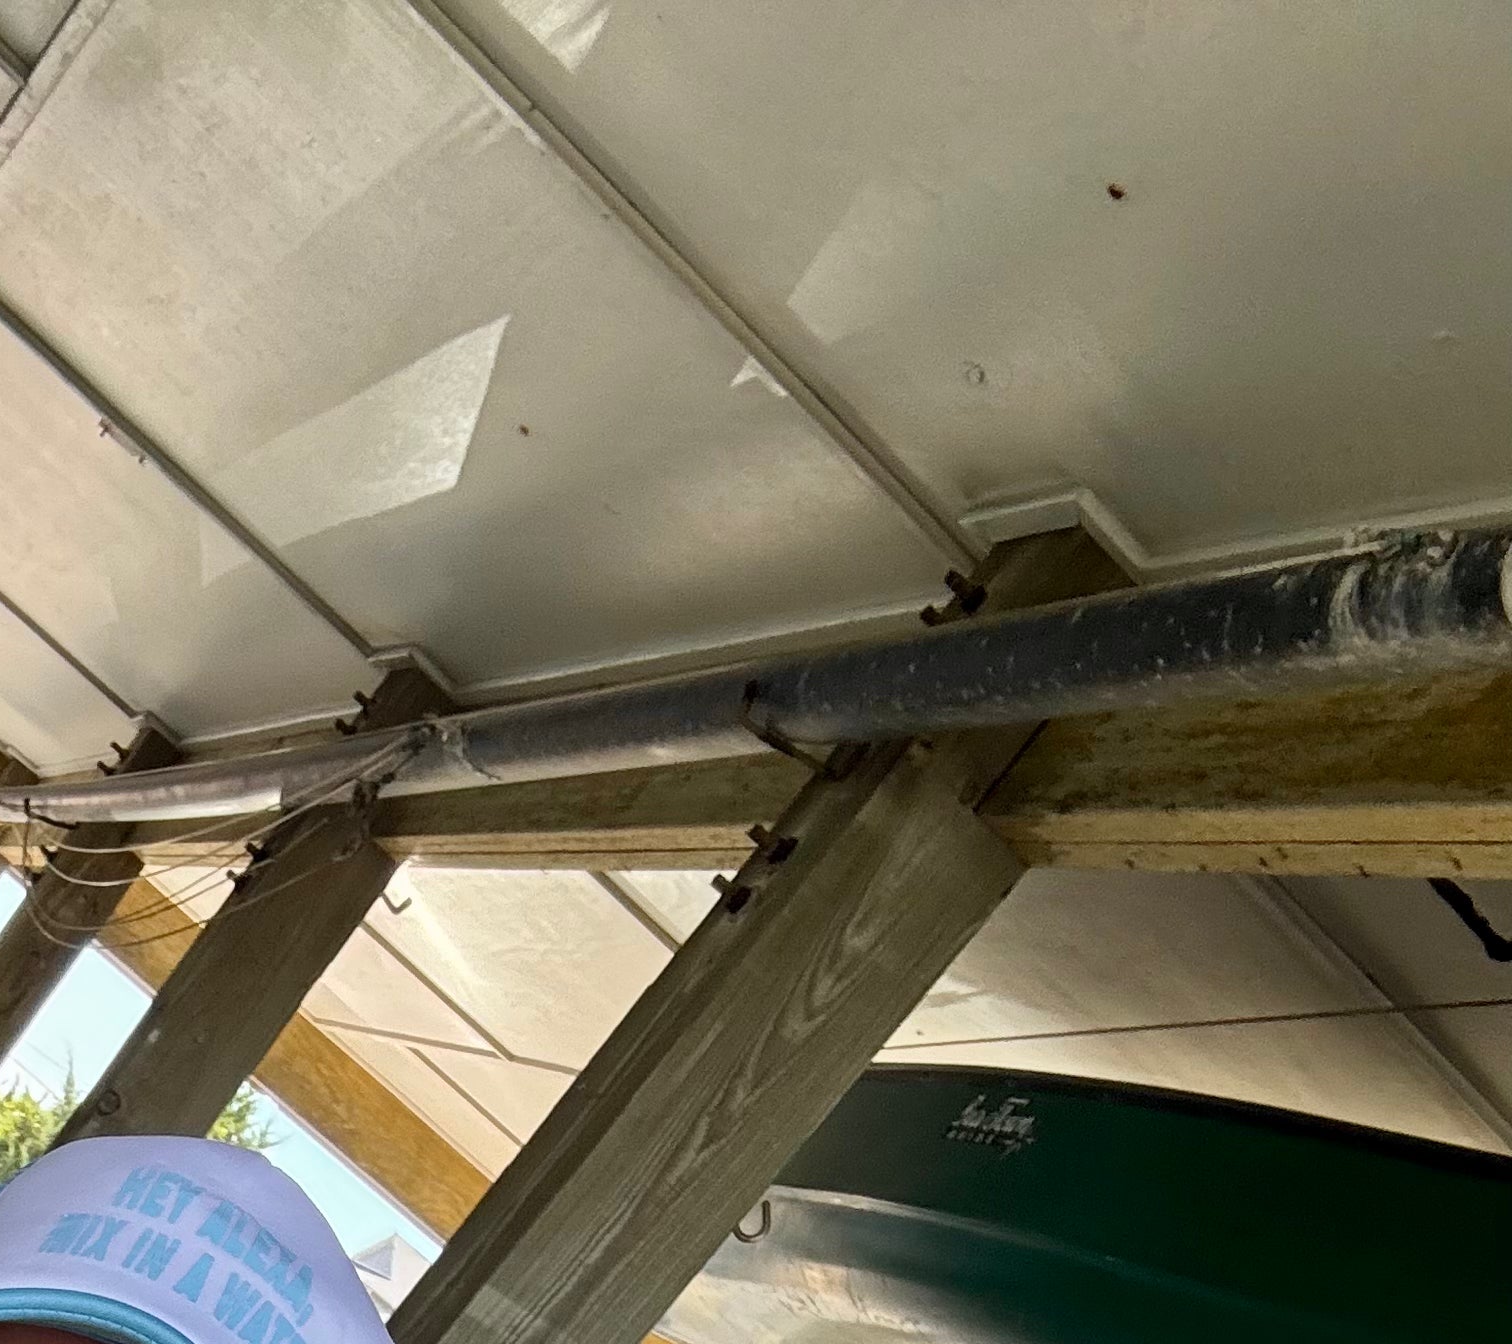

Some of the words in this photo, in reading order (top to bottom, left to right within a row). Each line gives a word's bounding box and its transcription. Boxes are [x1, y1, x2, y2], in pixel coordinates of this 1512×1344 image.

[111, 1165, 206, 1225] HEY
[38, 1213, 128, 1262] MIX
[121, 1227, 182, 1281] IN
[173, 1252, 215, 1304] A
